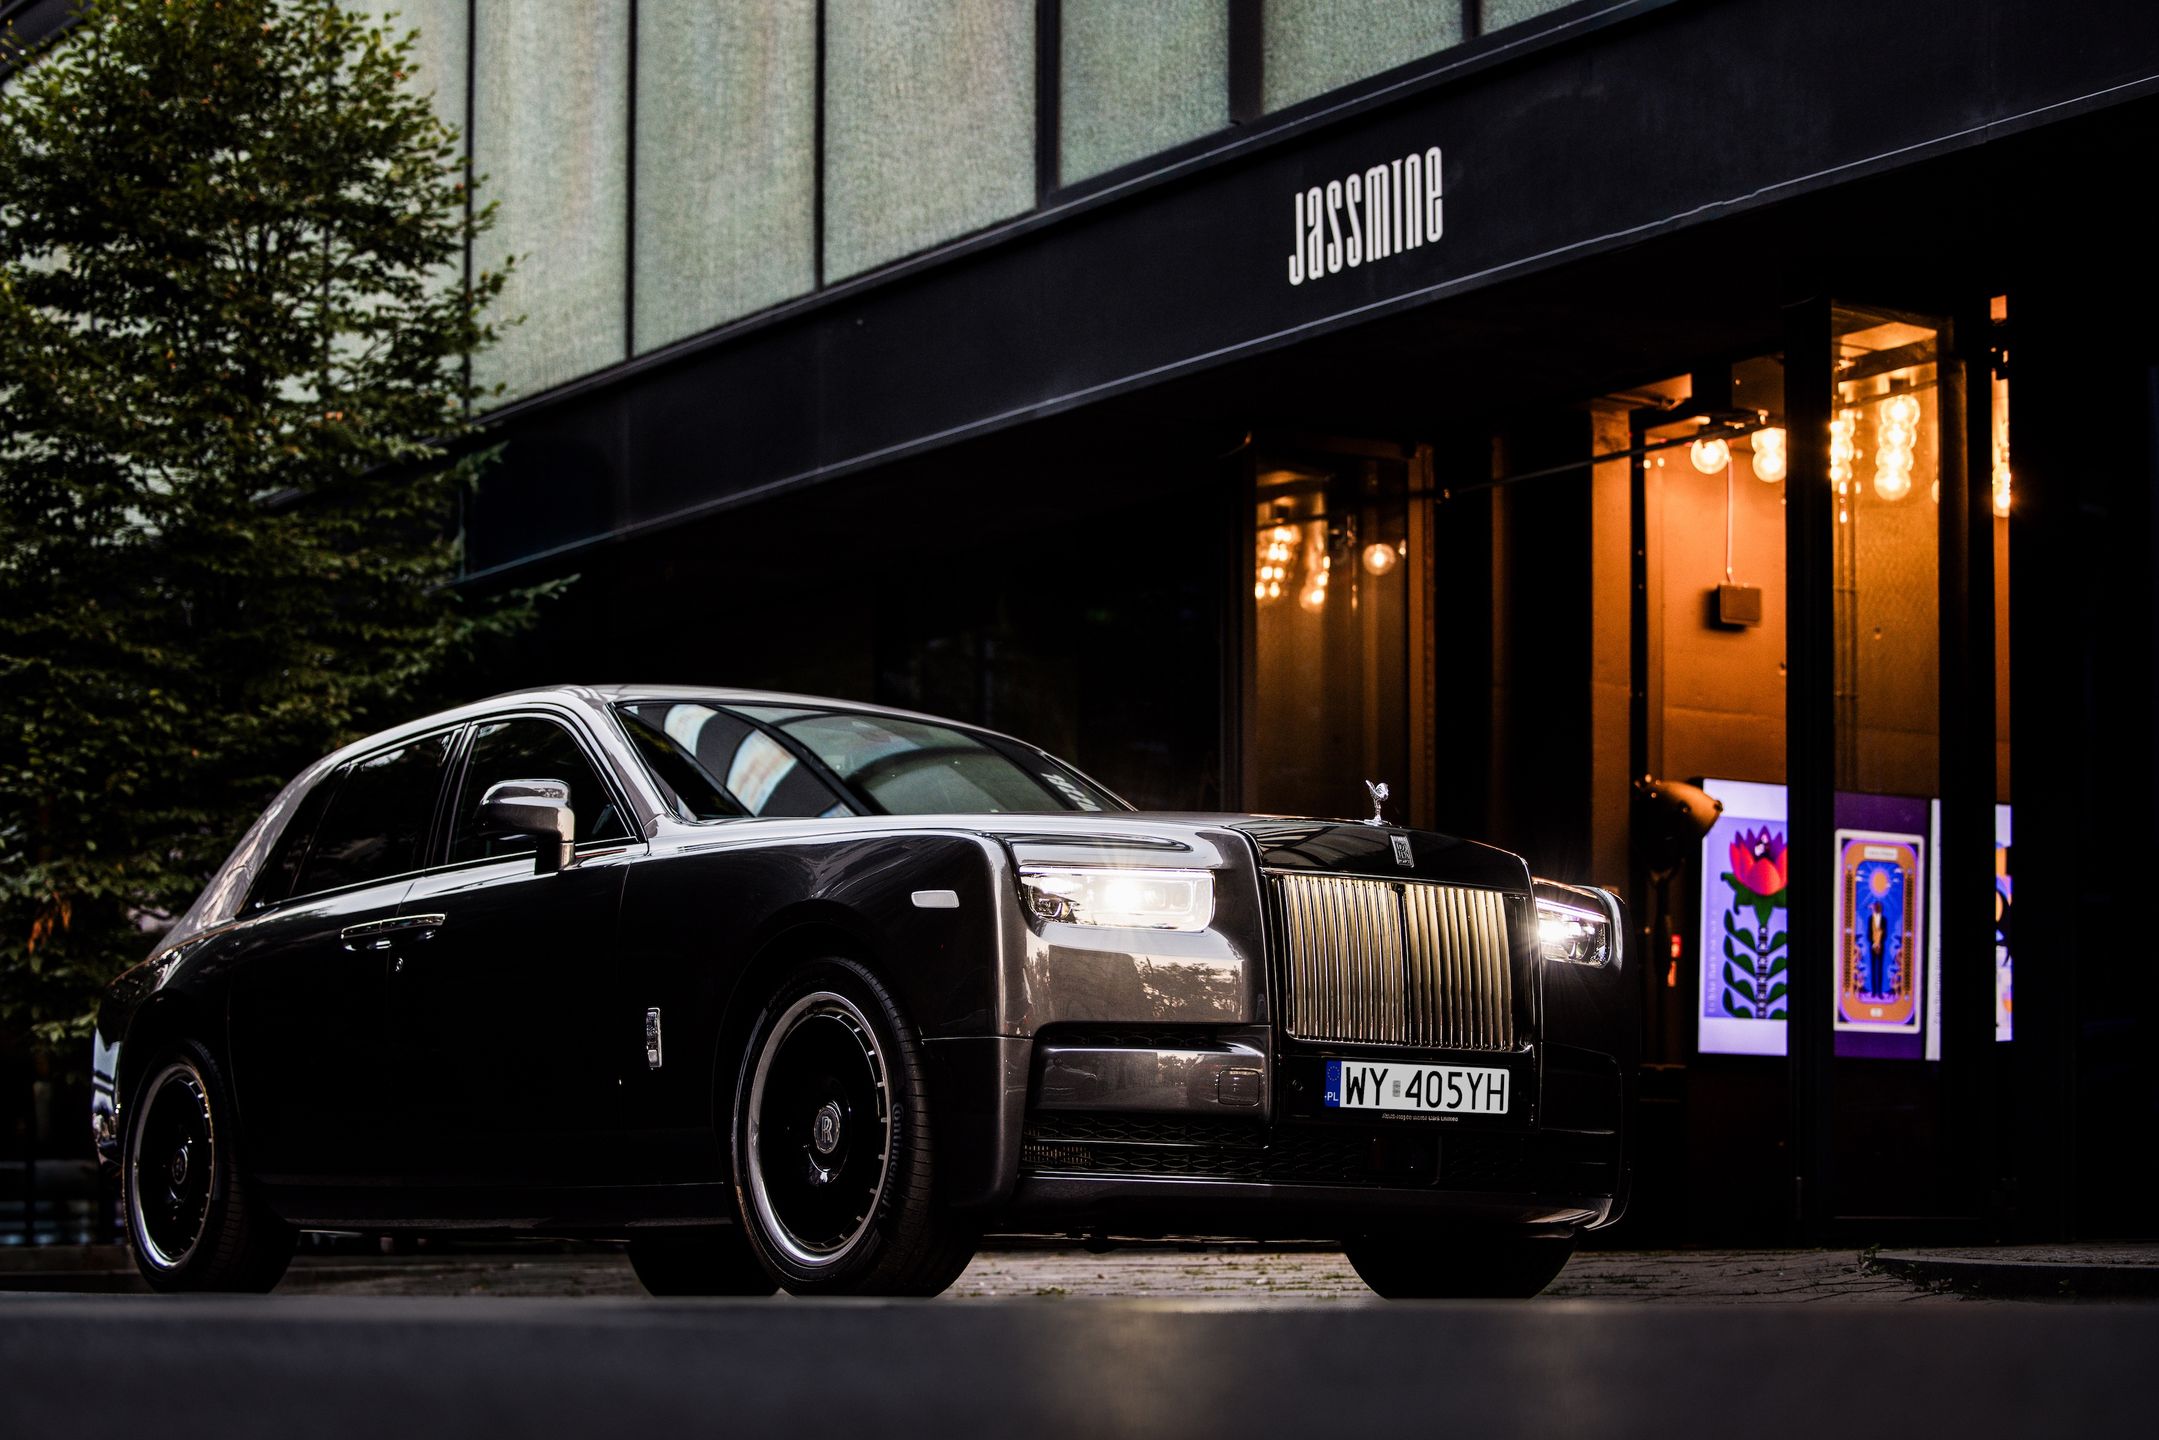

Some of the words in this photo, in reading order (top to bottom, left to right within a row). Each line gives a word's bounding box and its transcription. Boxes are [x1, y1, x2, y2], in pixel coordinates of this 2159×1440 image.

[1327, 1091, 1339, 1102] PL
[1345, 1066, 1389, 1106] WY
[1404, 1069, 1506, 1112] 405YH
